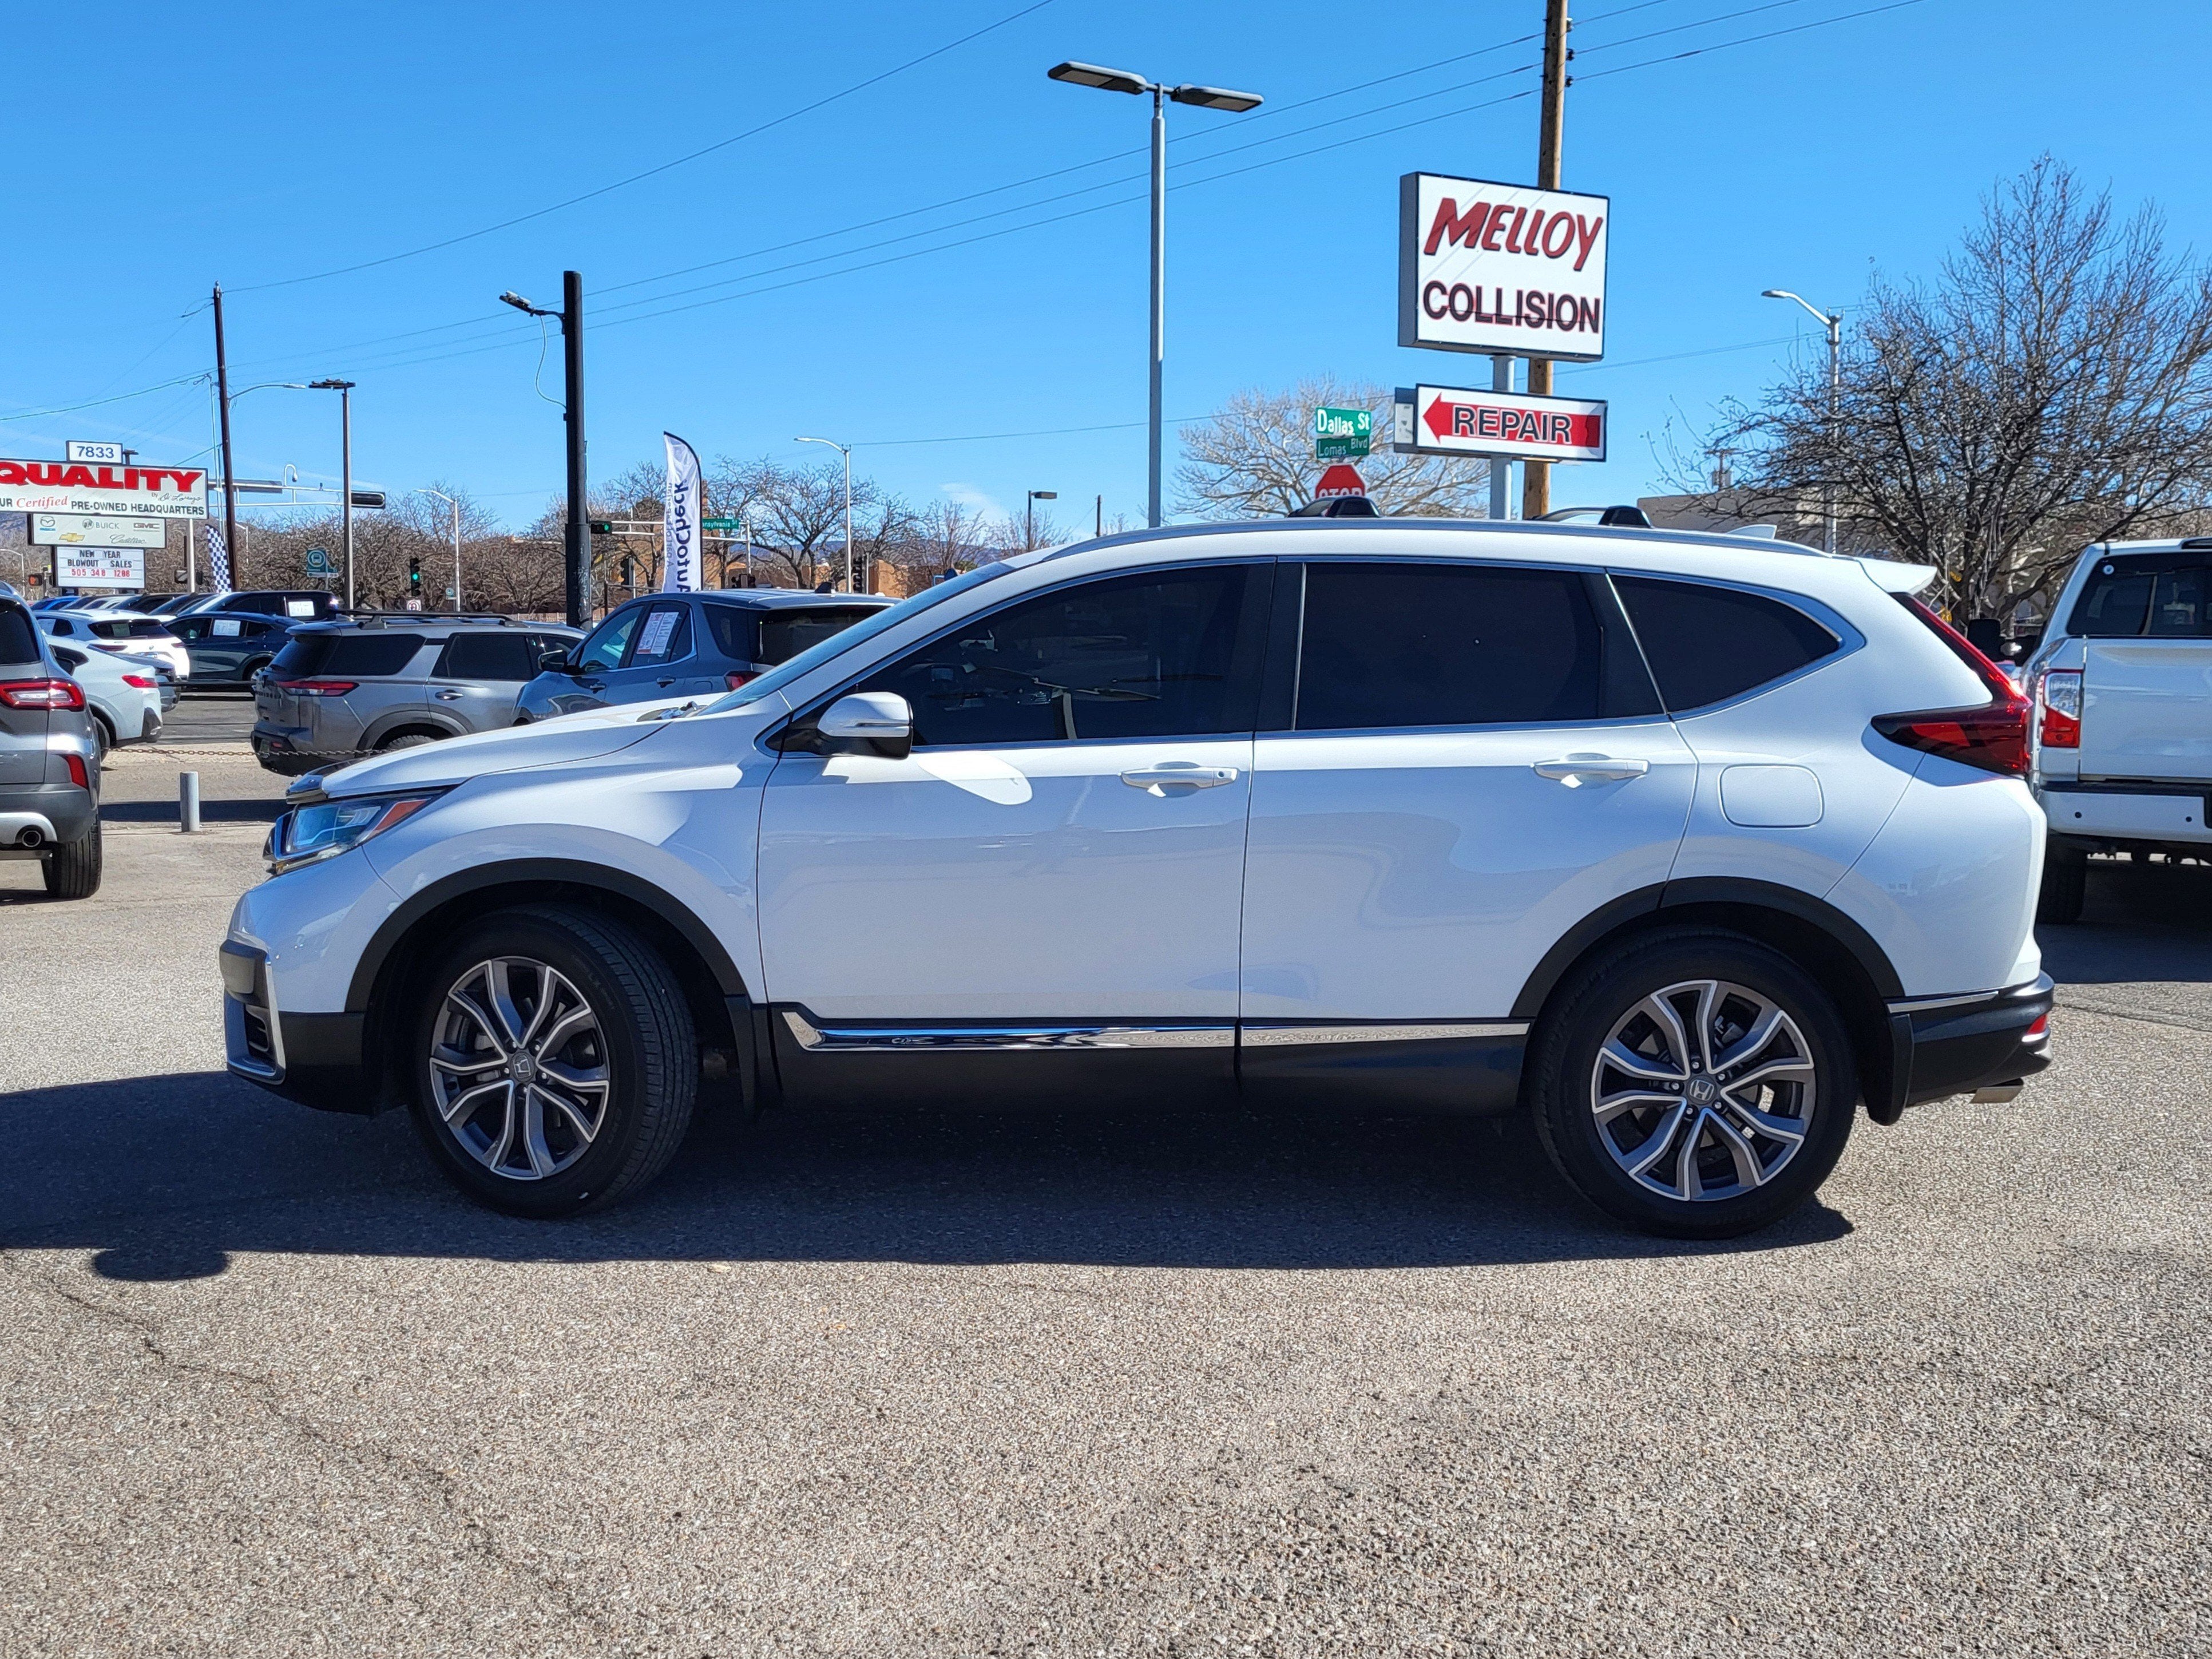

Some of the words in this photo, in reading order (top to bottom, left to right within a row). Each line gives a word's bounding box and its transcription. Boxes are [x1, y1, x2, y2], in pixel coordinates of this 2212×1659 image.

[1423, 197, 1603, 272] MELLOY
[1423, 280, 1601, 334] COLLISION
[1317, 409, 1355, 435] Dallas
[1357, 412, 1370, 430] St
[1452, 405, 1572, 444] REPAIR
[76, 446, 114, 458] 7833
[1318, 441, 1347, 457] Lomas
[1350, 437, 1368, 449] Blvd
[0, 461, 203, 493] QUALITY
[16, 495, 68, 509] Certified
[71, 501, 127, 512] PRE-OWNED
[130, 503, 204, 515] HEADQUARTERS
[95, 521, 120, 529] BUICK
[109, 534, 146, 544] Cadillac
[67, 559, 99, 567] BLOWOUT
[110, 560, 132, 568] SALES
[79, 549, 95, 558] NEW
[103, 550, 121, 559] YEAR
[71, 568, 86, 576] 505
[90, 569, 106, 577] 348
